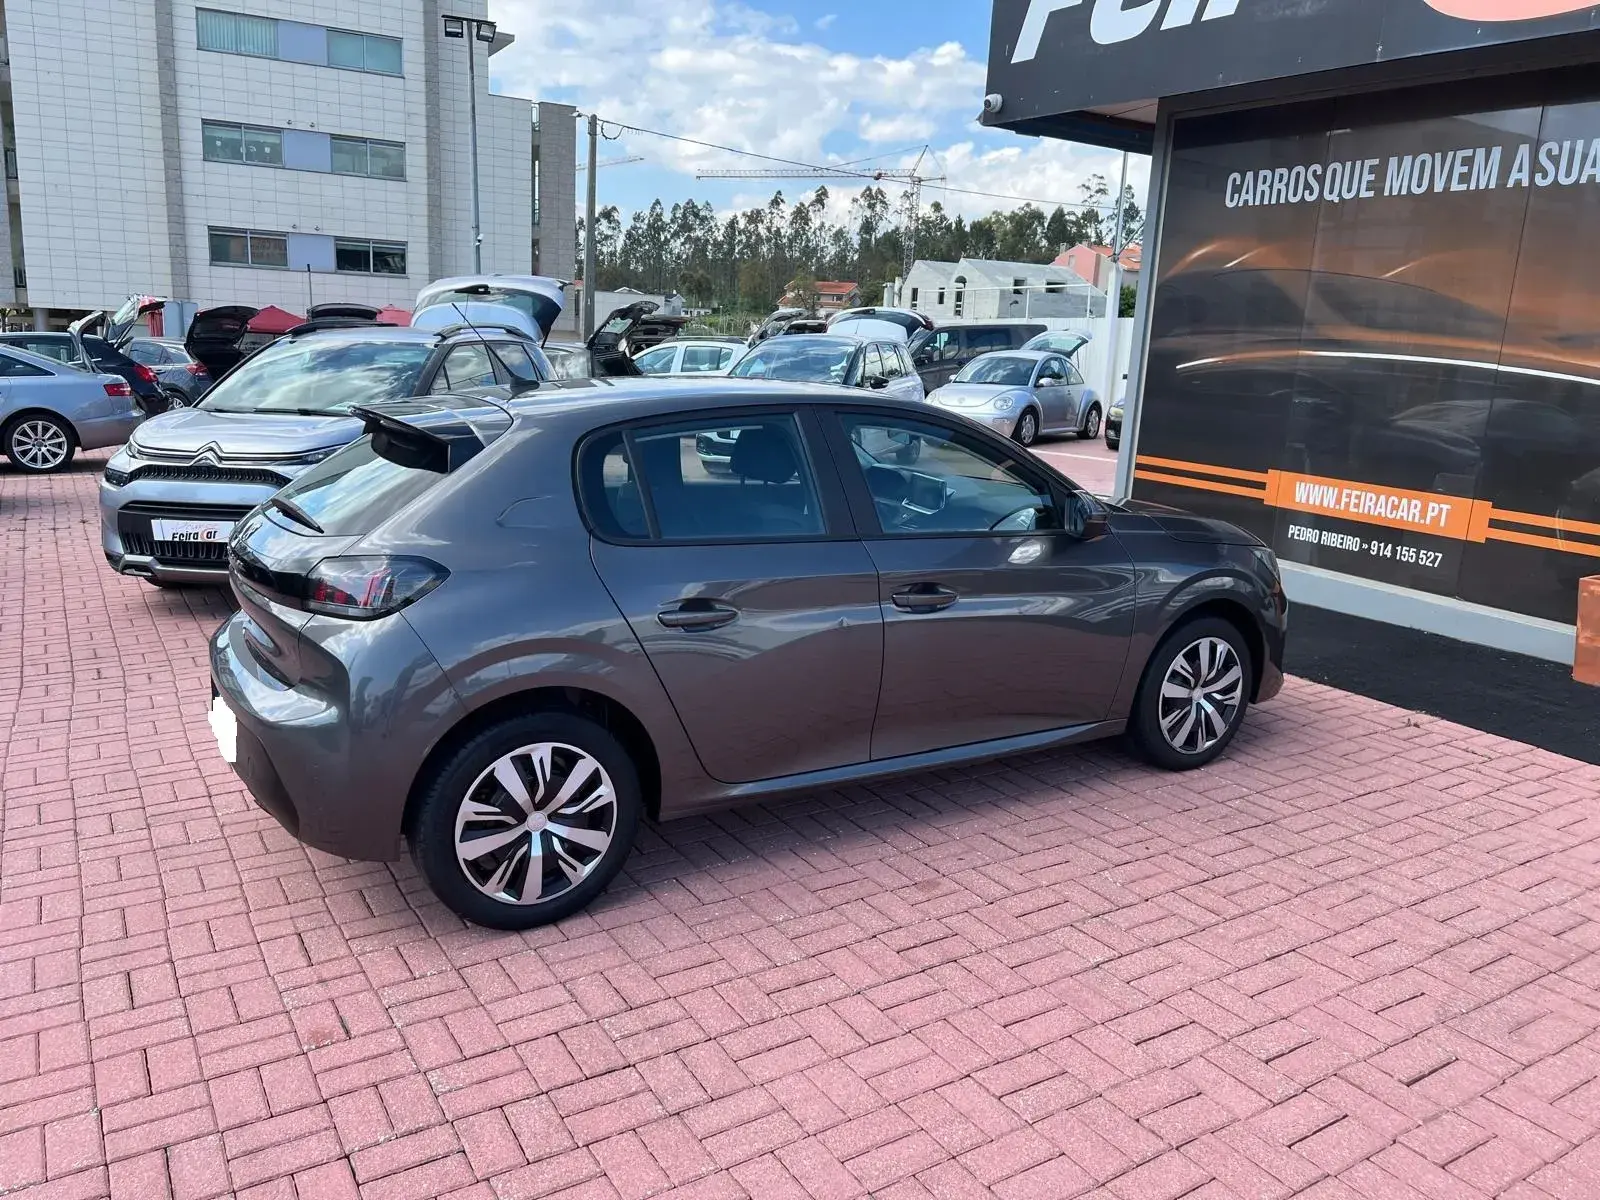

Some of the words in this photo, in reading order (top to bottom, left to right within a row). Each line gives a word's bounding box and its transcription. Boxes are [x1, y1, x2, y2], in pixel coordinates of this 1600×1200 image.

[1225, 163, 1322, 208] CARROS
[1323, 158, 1380, 203] QUE
[1383, 146, 1502, 197] MOVEM
[1506, 143, 1530, 188] A
[1534, 137, 1600, 187] SUA
[1294, 481, 1451, 527] WWW.FEIRACAR.PT
[1288, 524, 1319, 544] PEDRO
[1320, 531, 1360, 552] RIBEIRO
[1369, 540, 1392, 559] 914
[1395, 545, 1417, 563] 155
[1418, 550, 1443, 568] 527
